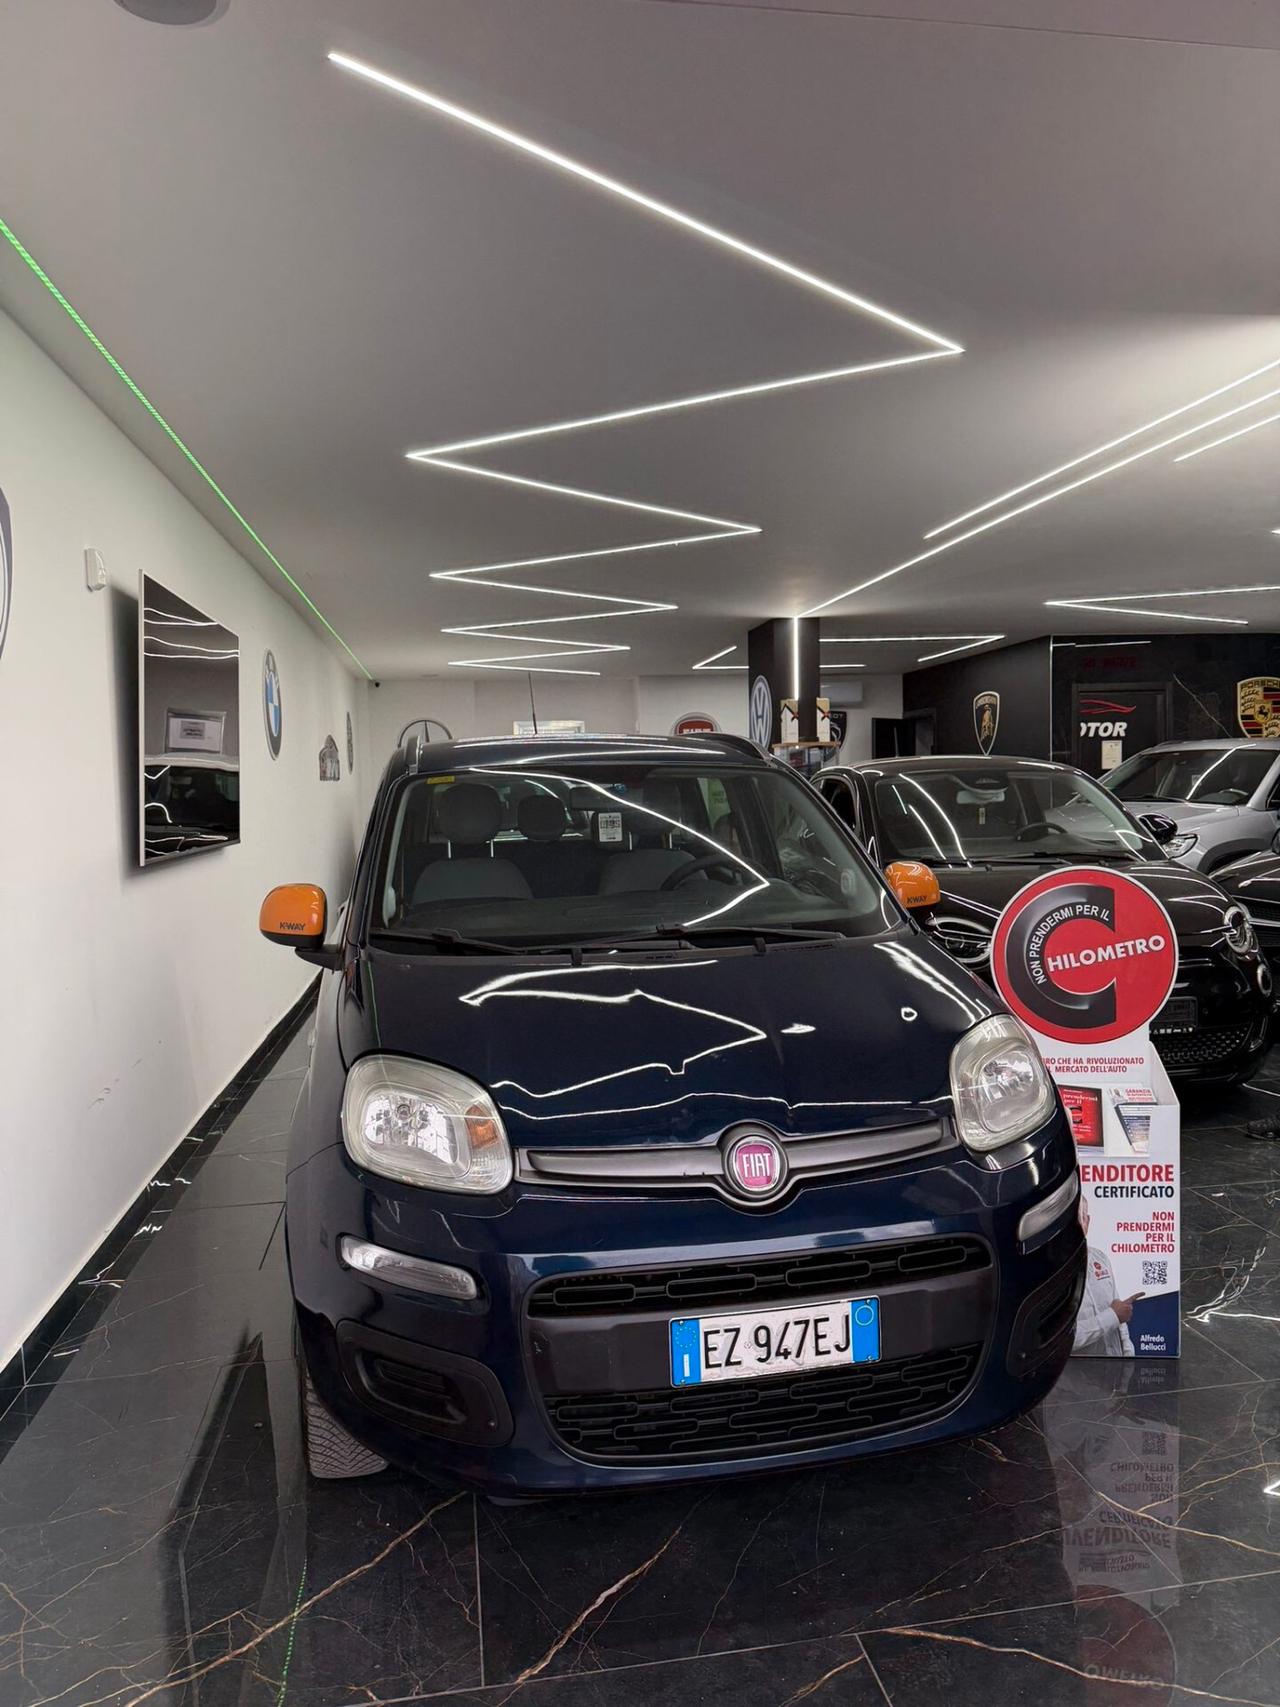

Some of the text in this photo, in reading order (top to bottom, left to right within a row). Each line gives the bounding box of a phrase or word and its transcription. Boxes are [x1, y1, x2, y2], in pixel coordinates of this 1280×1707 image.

[1029, 904, 1111, 985] NON PRENDERMI PER IL
[1057, 1057, 1072, 1065] CHE
[1073, 1057, 1084, 1065] HA
[1086, 1057, 1144, 1065] RIVOLUZIONATO
[742, 1153, 771, 1178] FIAT
[1094, 1186, 1175, 1198] CERTIFICATO
[1152, 1211, 1175, 1221] NON
[1117, 1222, 1175, 1232] PRENDERMI
[1145, 1233, 1176, 1242] PER IL
[1111, 1243, 1175, 1253] CHILOMETRO
[703, 1327, 742, 1369] EZ
[754, 1314, 851, 1363] 947EJ
[1140, 1334, 1165, 1342] Alfredo
[1140, 1343, 1166, 1351] Bellucci
